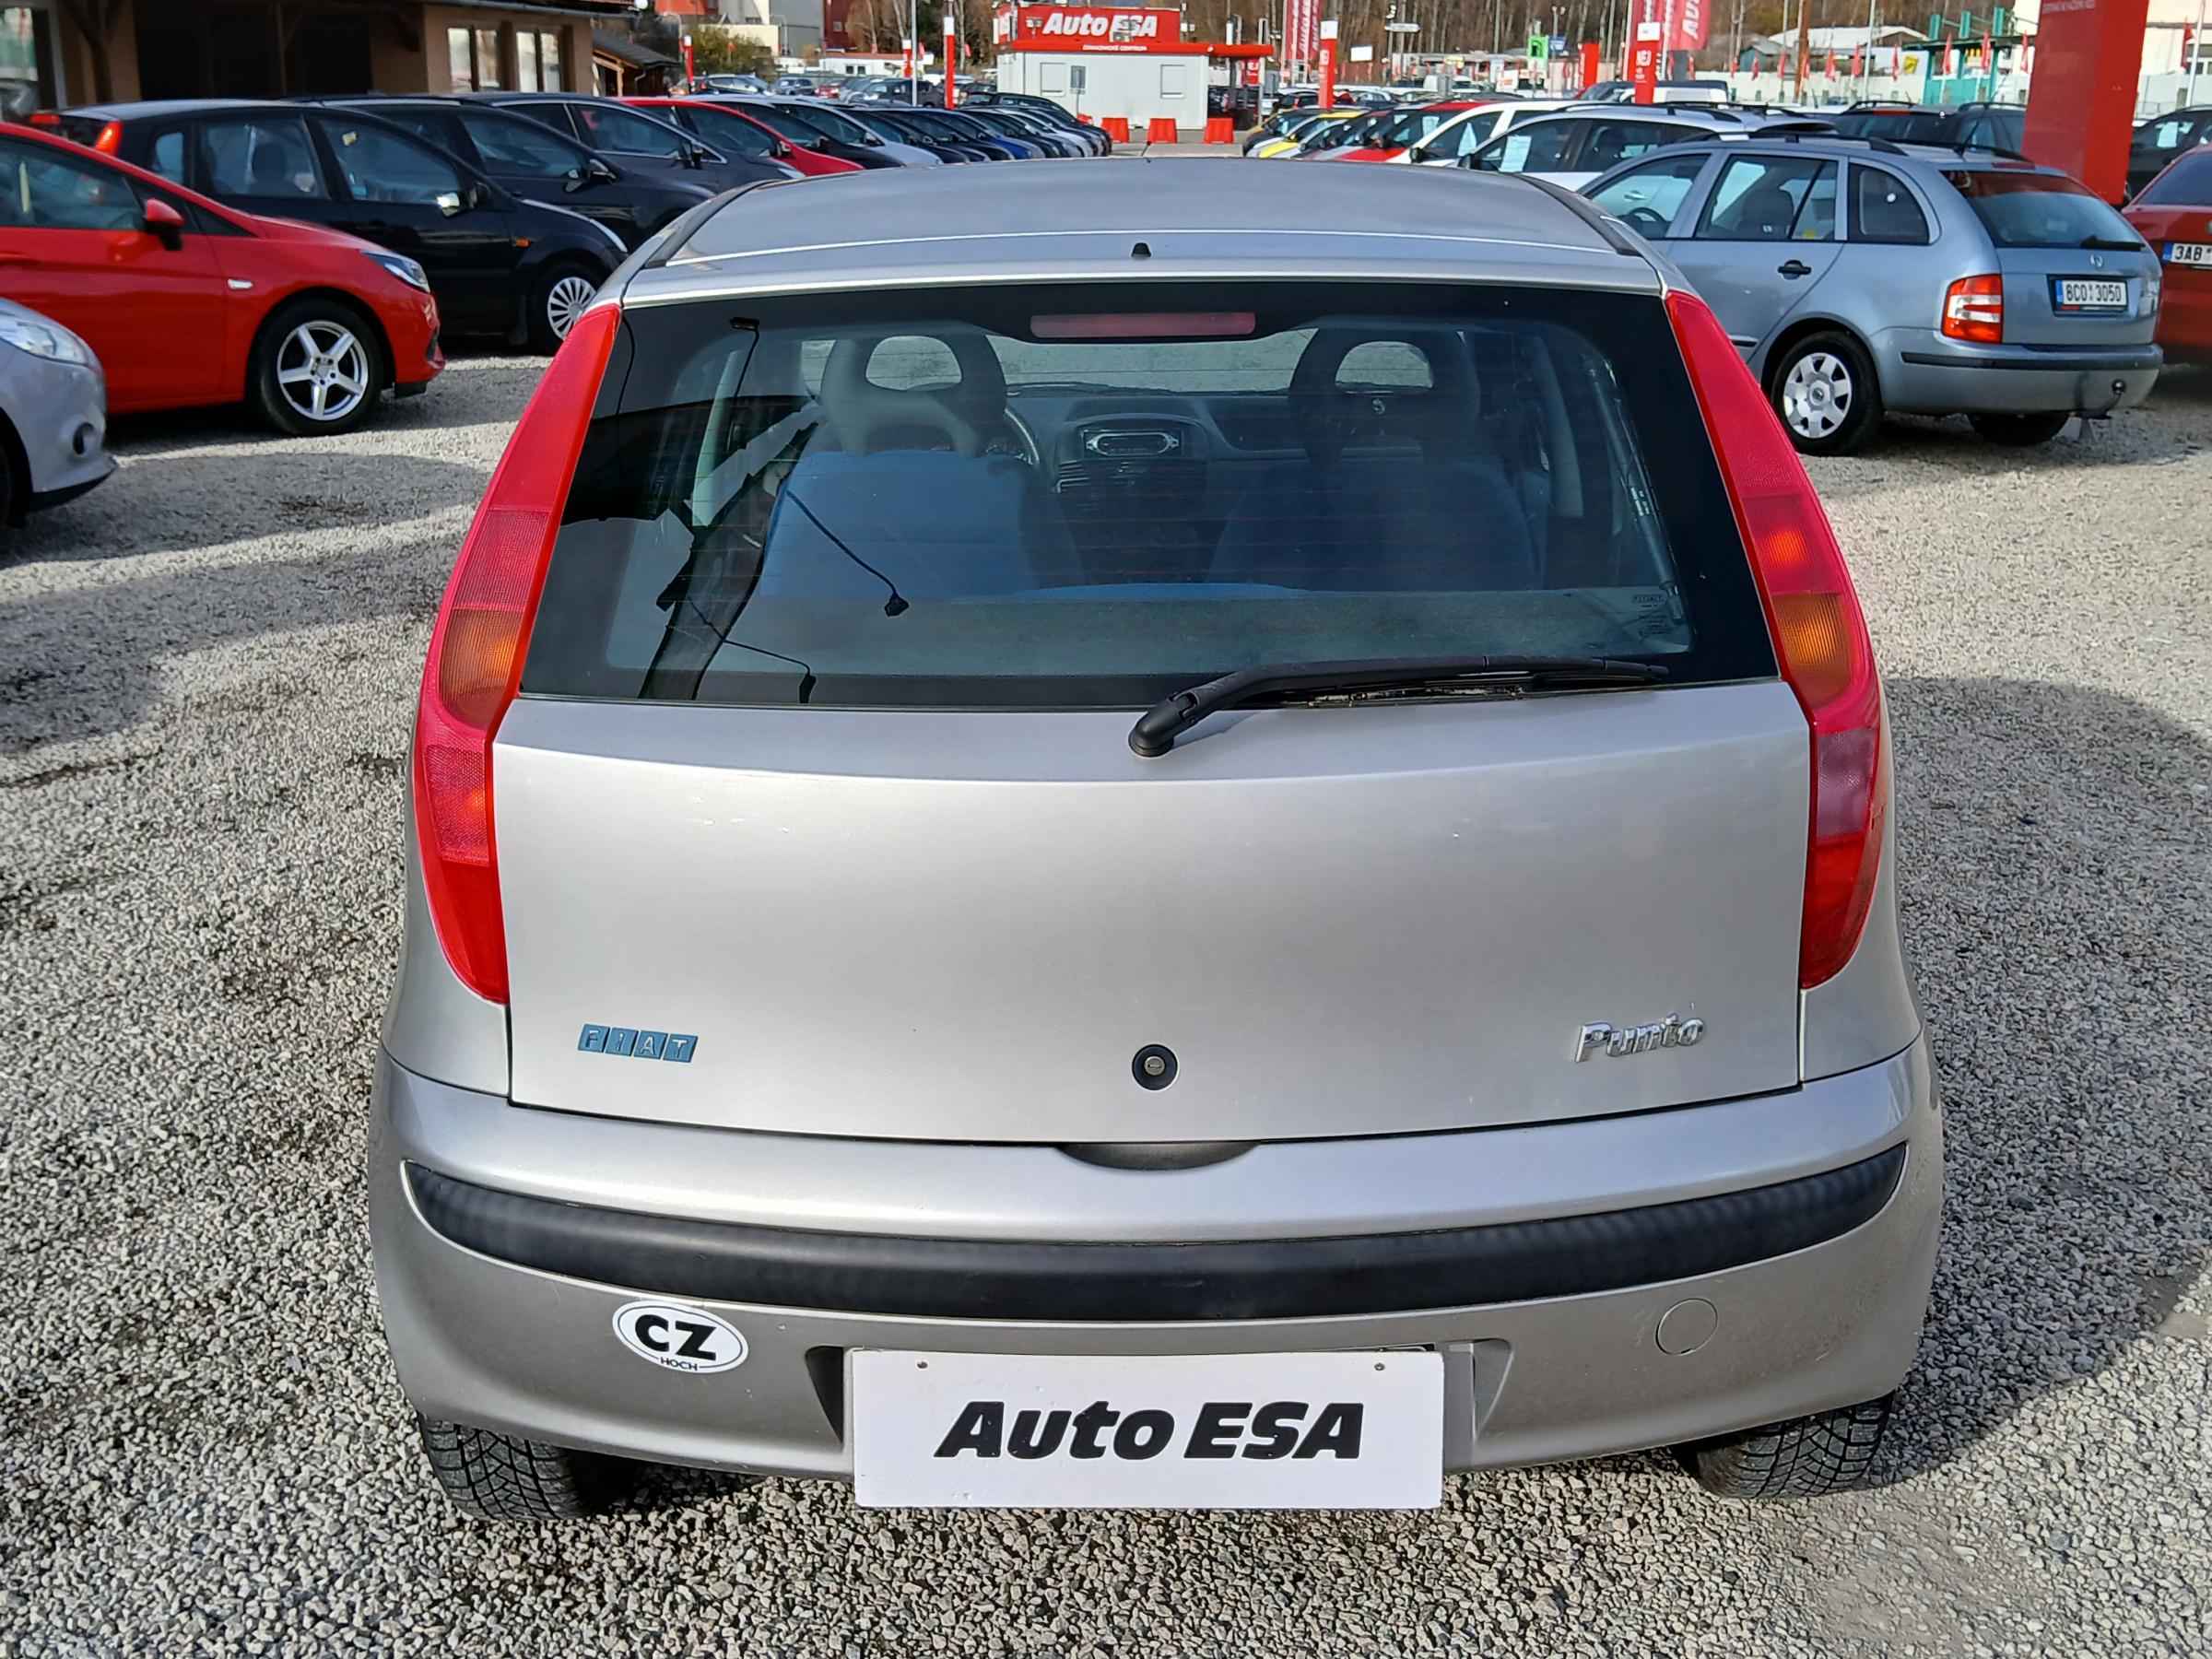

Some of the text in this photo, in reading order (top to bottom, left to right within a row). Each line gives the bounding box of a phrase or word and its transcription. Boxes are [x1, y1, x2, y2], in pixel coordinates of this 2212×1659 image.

[1042, 12, 1158, 38] Auto ESA
[2175, 245, 2203, 262] 3AB
[2095, 284, 2122, 302] 3050
[582, 1027, 694, 1061] FIAT
[1575, 1013, 1705, 1063] Punto
[635, 1314, 717, 1360] CZ
[660, 1356, 699, 1371] HOCH
[933, 1400, 1364, 1460] Auto ESA
